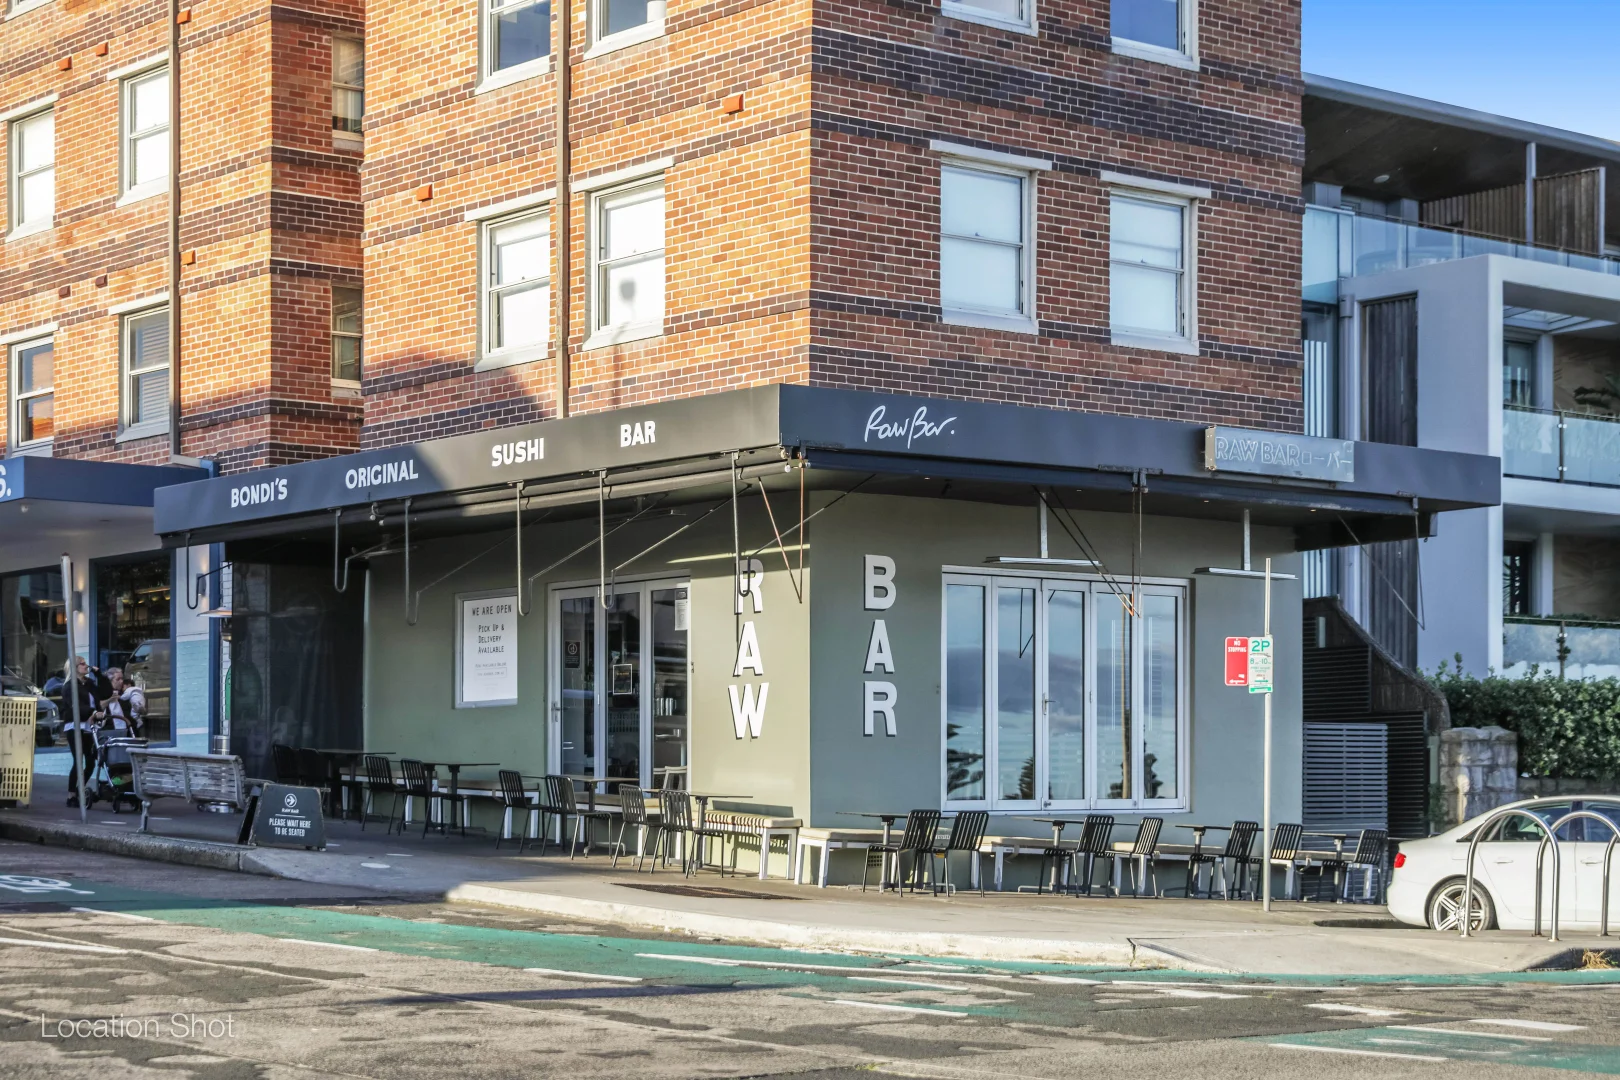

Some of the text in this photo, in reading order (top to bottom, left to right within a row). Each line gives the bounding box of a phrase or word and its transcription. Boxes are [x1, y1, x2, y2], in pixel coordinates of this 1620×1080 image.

[345, 459, 419, 490] ORIGINAL
[491, 437, 545, 468] SUSHI
[620, 420, 656, 448] BAR
[1215, 436, 1300, 467] RAW BAR
[472, 604, 512, 616] WE ARE OPEN
[728, 558, 770, 740] RAW
[863, 553, 898, 738] BAR
[1251, 640, 1271, 652] 2P
[268, 818, 311, 828] PLEASE WAIT HERE
[282, 828, 288, 836] BE
[288, 828, 306, 837] SEATED
